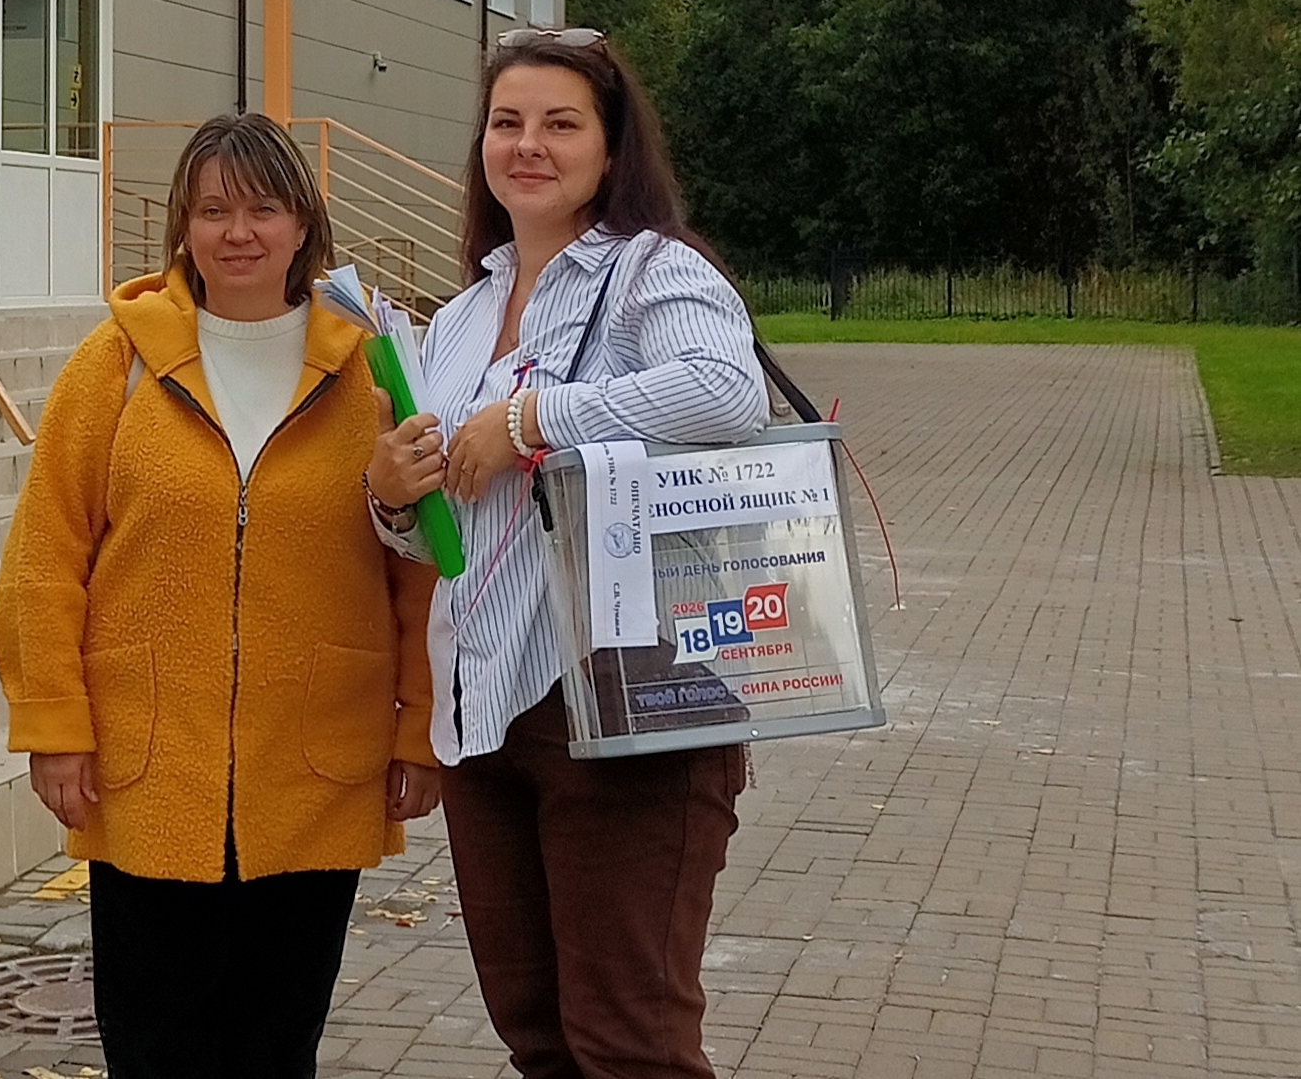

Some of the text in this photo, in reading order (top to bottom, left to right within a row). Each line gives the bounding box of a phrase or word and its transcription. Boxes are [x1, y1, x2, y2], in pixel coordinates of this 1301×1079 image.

[656, 462, 776, 488] УИК № 1722
[740, 490, 796, 509] ЯЩИК
[800, 488, 819, 503] №
[822, 487, 829, 501] 1
[631, 480, 642, 555] ОПЕЧАТАНО
[683, 563, 720, 578] ДЕНЬ
[723, 551, 826, 573] ГОЛОСОВАНИЯ
[672, 602, 705, 615] 2026
[680, 594, 783, 654] 18 19 20
[721, 642, 793, 660] СЕНТЯБРЯ
[636, 688, 677, 708] ТВОЙ
[679, 685, 727, 703] ГОЛОС
[741, 682, 780, 695] СИЛА
[784, 674, 843, 691] РОССИИ!
